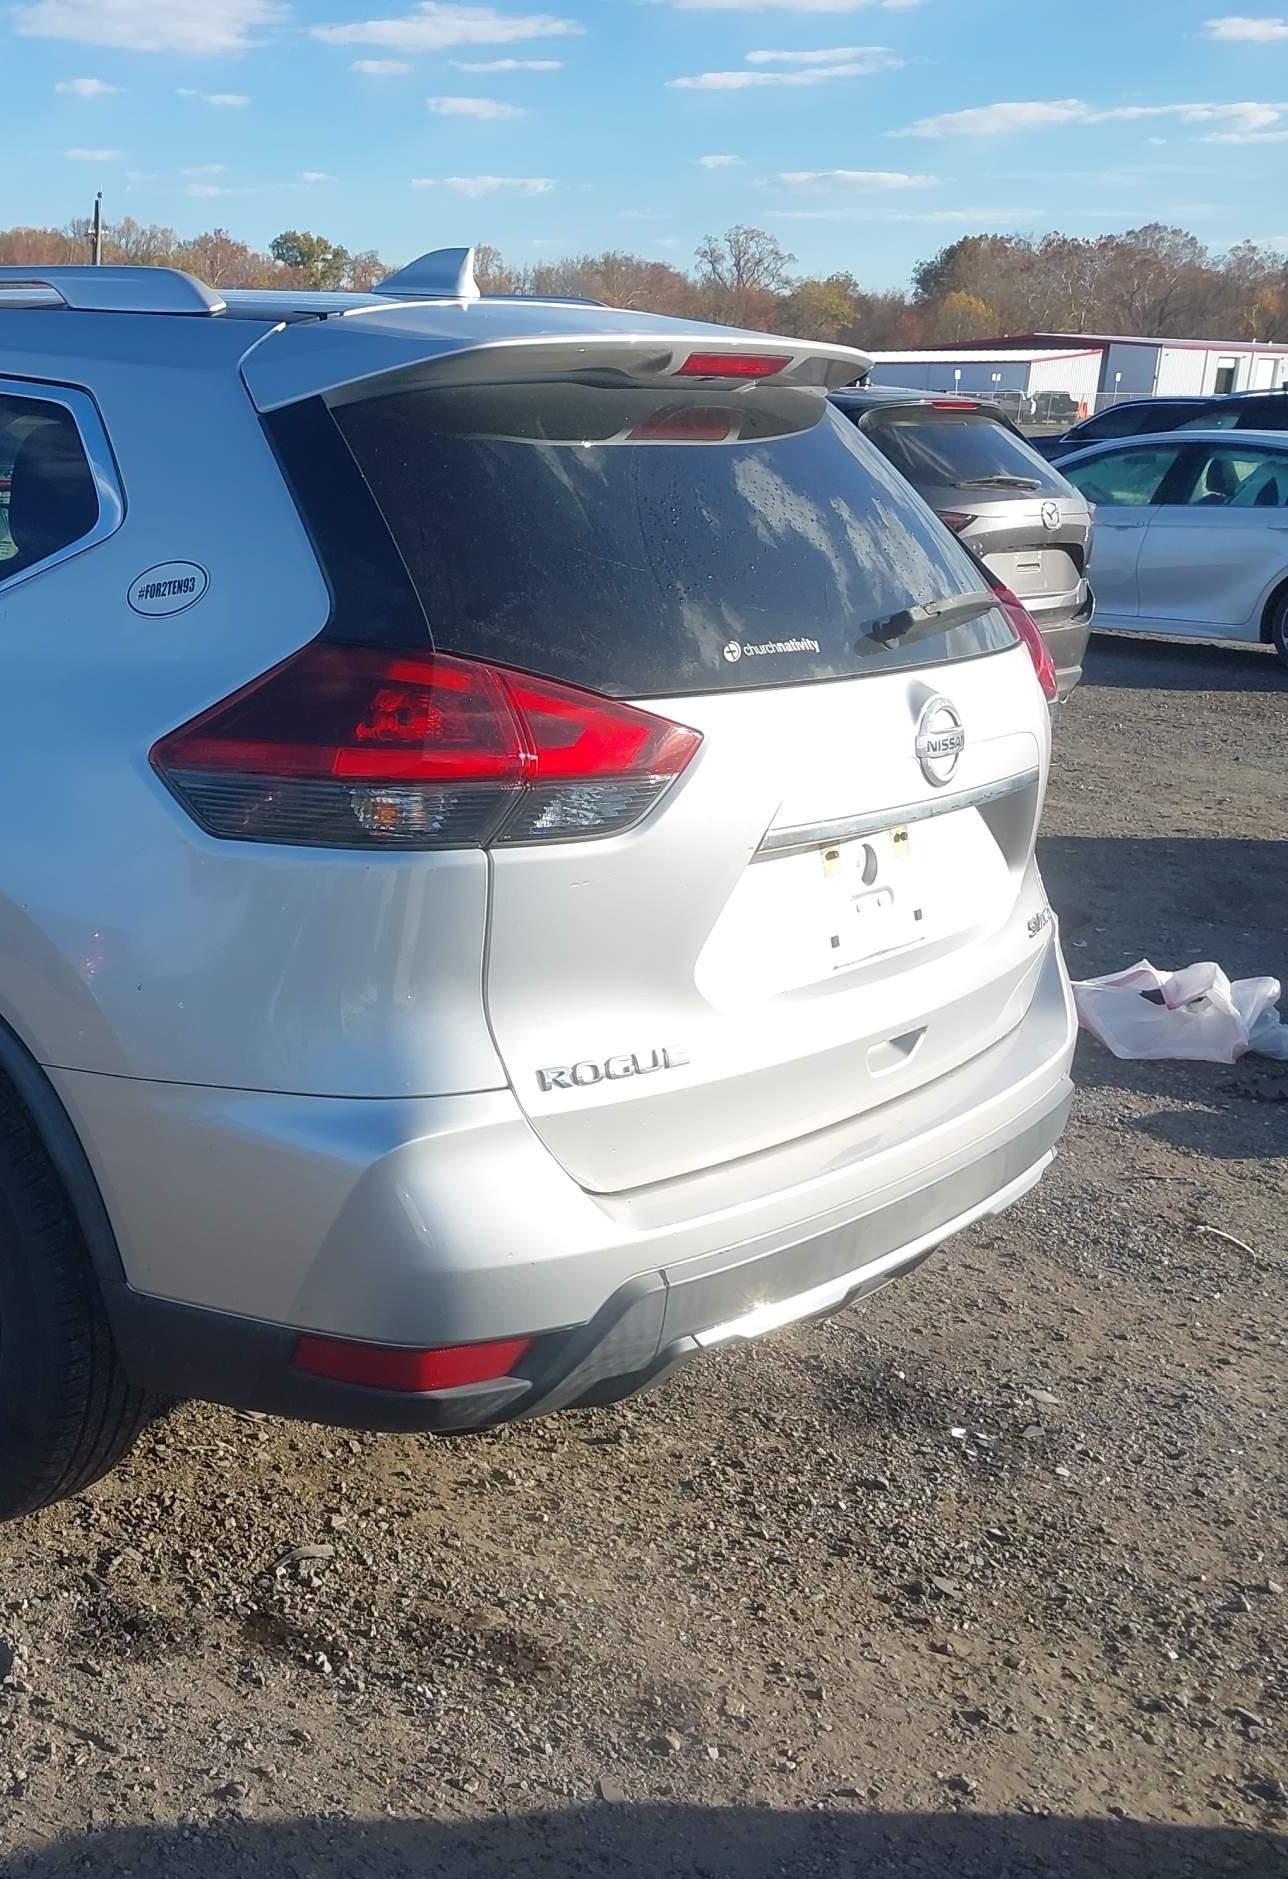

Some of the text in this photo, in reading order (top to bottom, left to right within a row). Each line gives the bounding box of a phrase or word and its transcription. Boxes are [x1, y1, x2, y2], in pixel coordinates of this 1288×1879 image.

[137, 577, 196, 601] #FOR2TEN93
[743, 638, 821, 656] churchnativity
[535, 1043, 691, 1092] ROGUE
